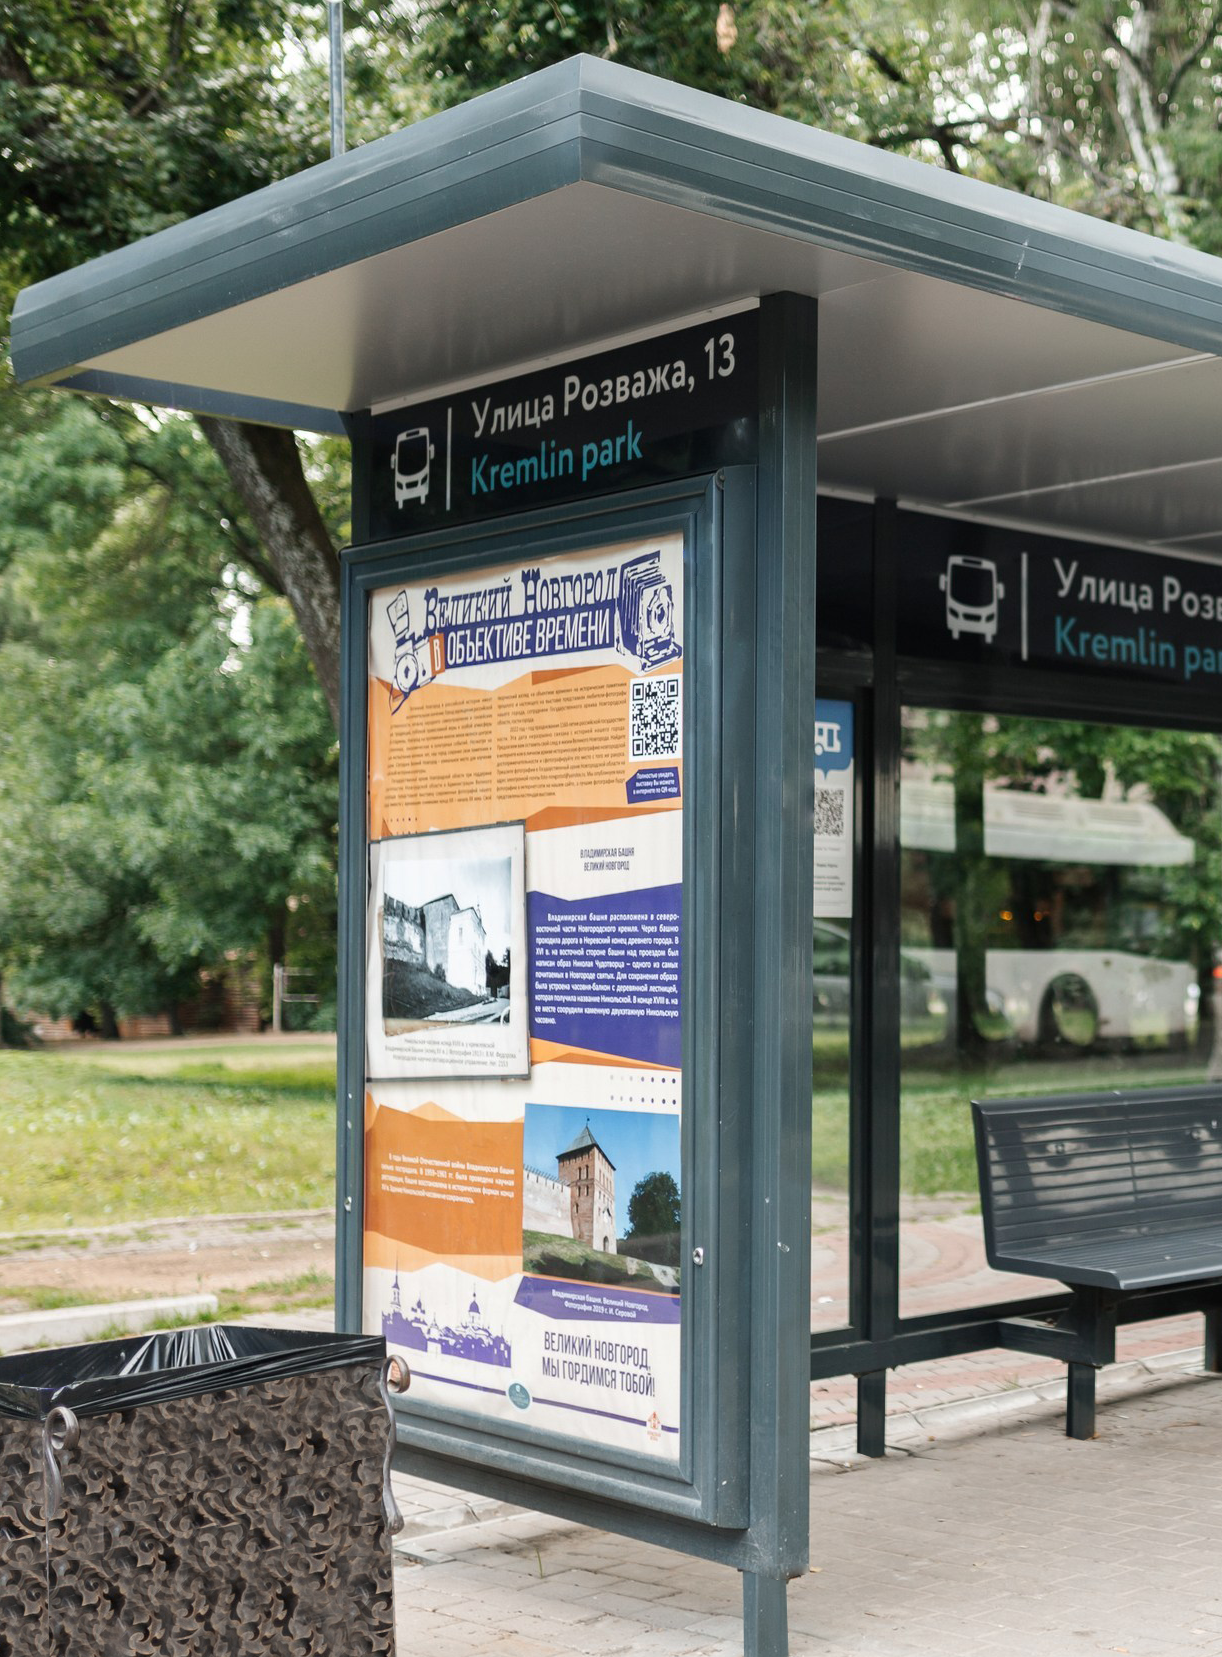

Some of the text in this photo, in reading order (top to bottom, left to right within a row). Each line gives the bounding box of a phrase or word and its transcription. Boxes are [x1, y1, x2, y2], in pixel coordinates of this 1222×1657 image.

[471, 333, 736, 438] Улица Розважа, 13
[471, 420, 643, 495] Kremlin park
[1054, 558, 1153, 612] Улица
[433, 608, 610, 671] В ОБЪЕКТИВЕ ВРЕМЕНИ
[1055, 616, 1176, 669] Kremlin
[580, 847, 635, 859] ВЛАДИМИРСКАЯ БАШНЯ
[584, 860, 629, 872] ВЕЛИКИЙ НОВГОРОД
[552, 1289, 585, 1301] Владимирская
[603, 1297, 623, 1307] Великий
[564, 1301, 592, 1311] Фотография
[615, 1309, 636, 1318] Серовой
[544, 1331, 651, 1371] ВЕЛИКИЙ НОВГОРОД,
[542, 1356, 655, 1397] МЫ ГОРДИМСЯ ТОБОЙ!
